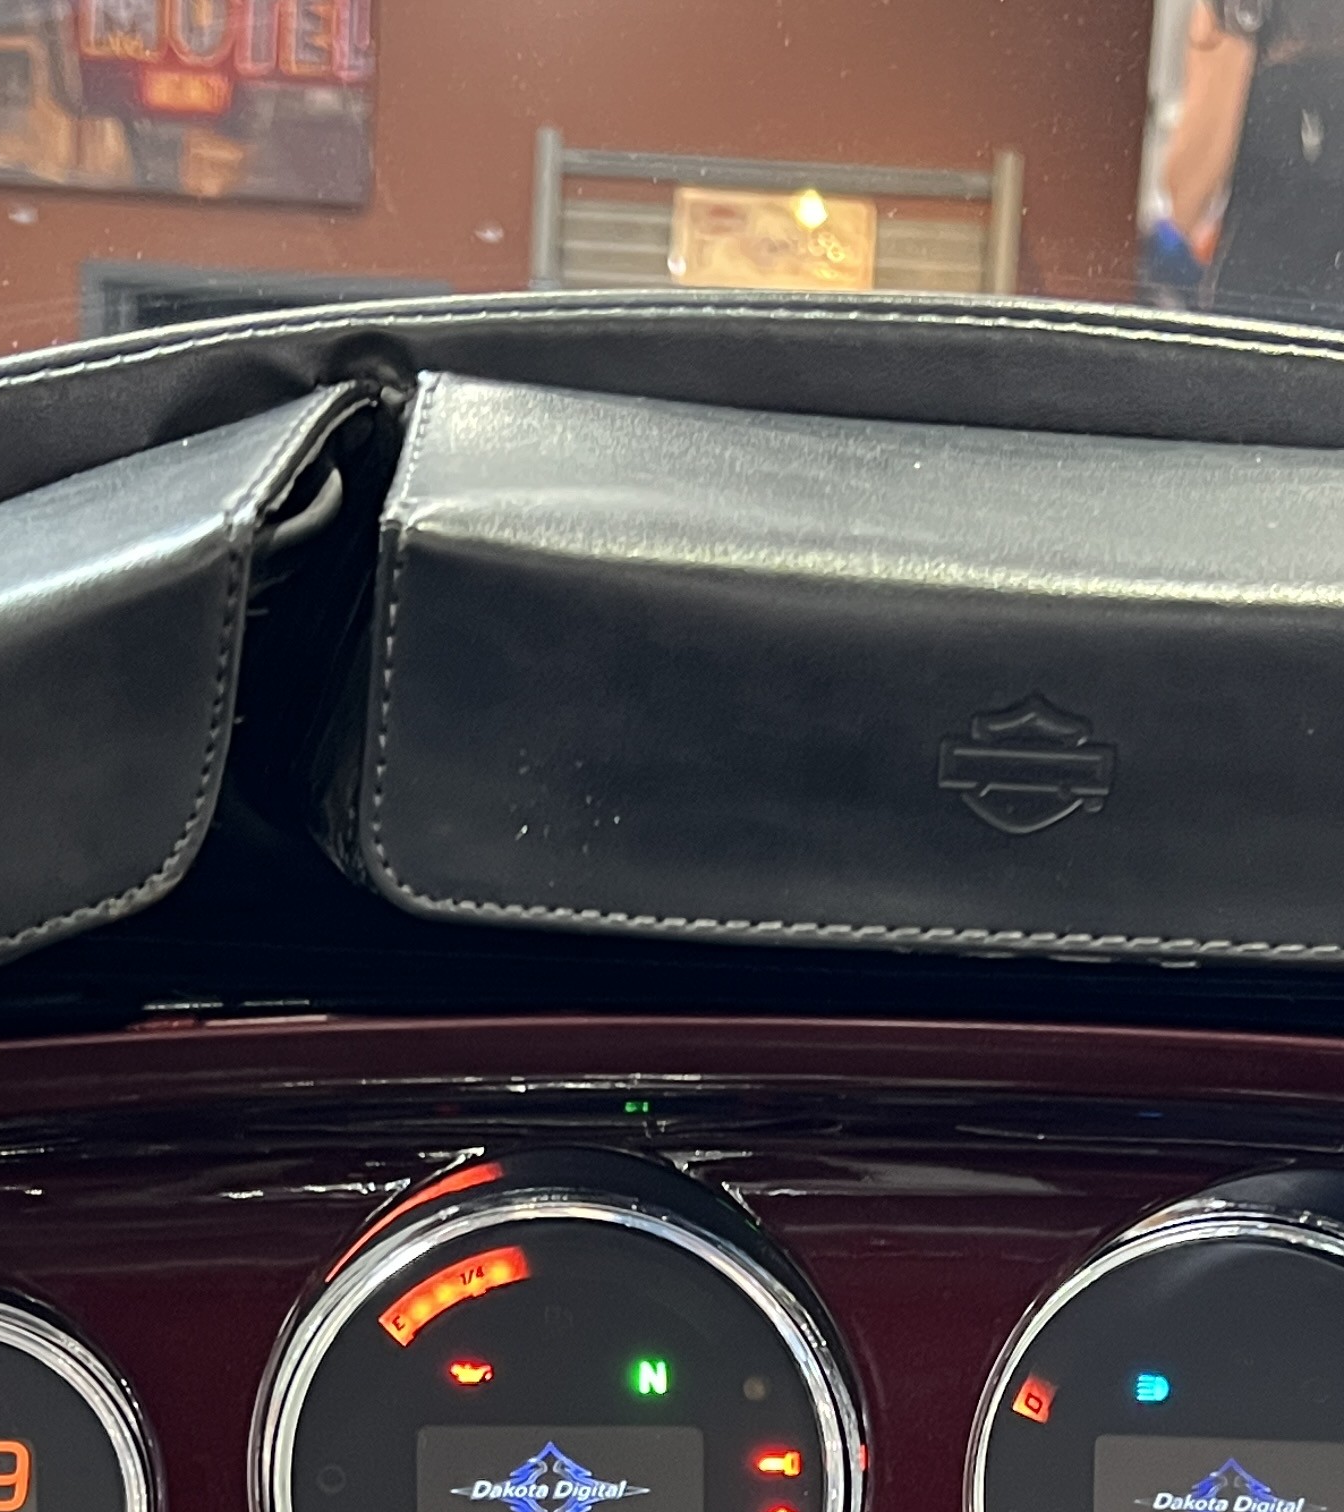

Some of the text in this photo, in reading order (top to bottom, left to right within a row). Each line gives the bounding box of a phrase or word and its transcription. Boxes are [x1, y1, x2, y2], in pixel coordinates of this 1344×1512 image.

[639, 1360, 668, 1395] N
[469, 1479, 627, 1501] Dakota Digital
[1152, 1492, 1229, 1512] Dakota
